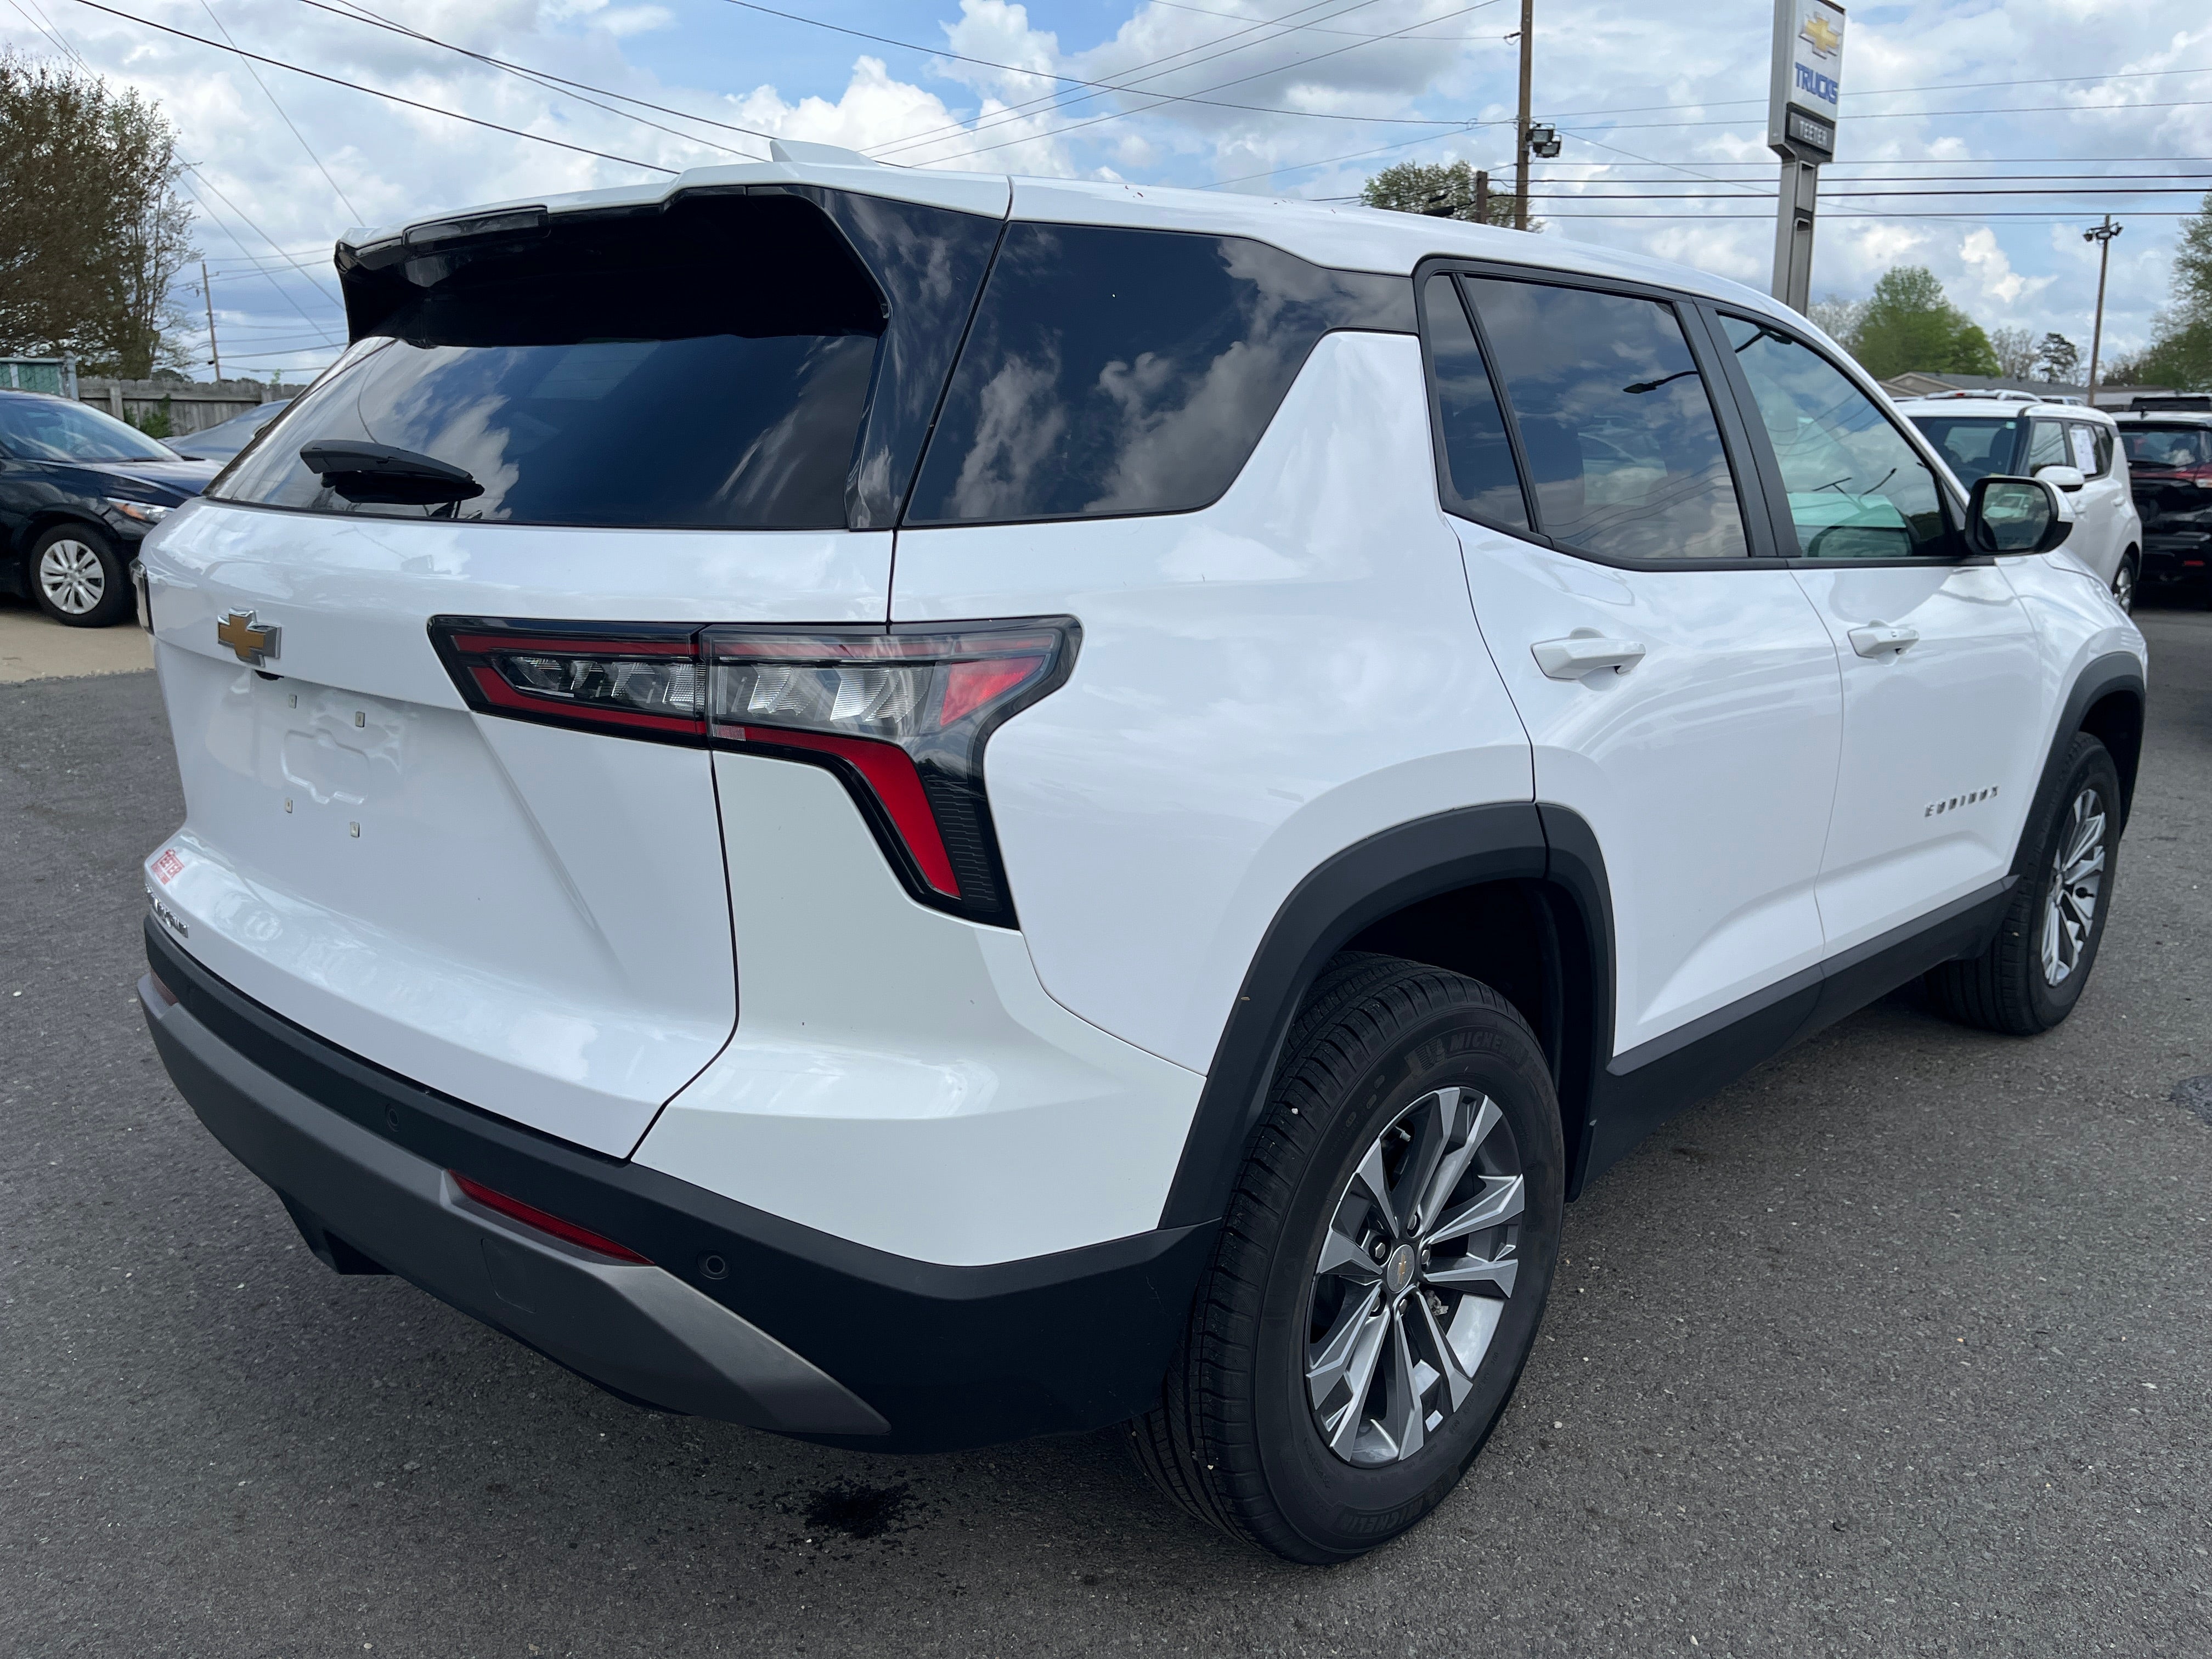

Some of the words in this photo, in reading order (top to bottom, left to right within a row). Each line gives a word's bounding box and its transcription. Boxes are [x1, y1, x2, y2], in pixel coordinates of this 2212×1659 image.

[1795, 61, 1838, 105] TRUCKS
[1799, 120, 1827, 146] TEETER
[1925, 785, 1999, 817] EQUINOX
[1449, 1031, 1528, 1064] MICHELIN
[1340, 1497, 1424, 1534] MICHELIN
